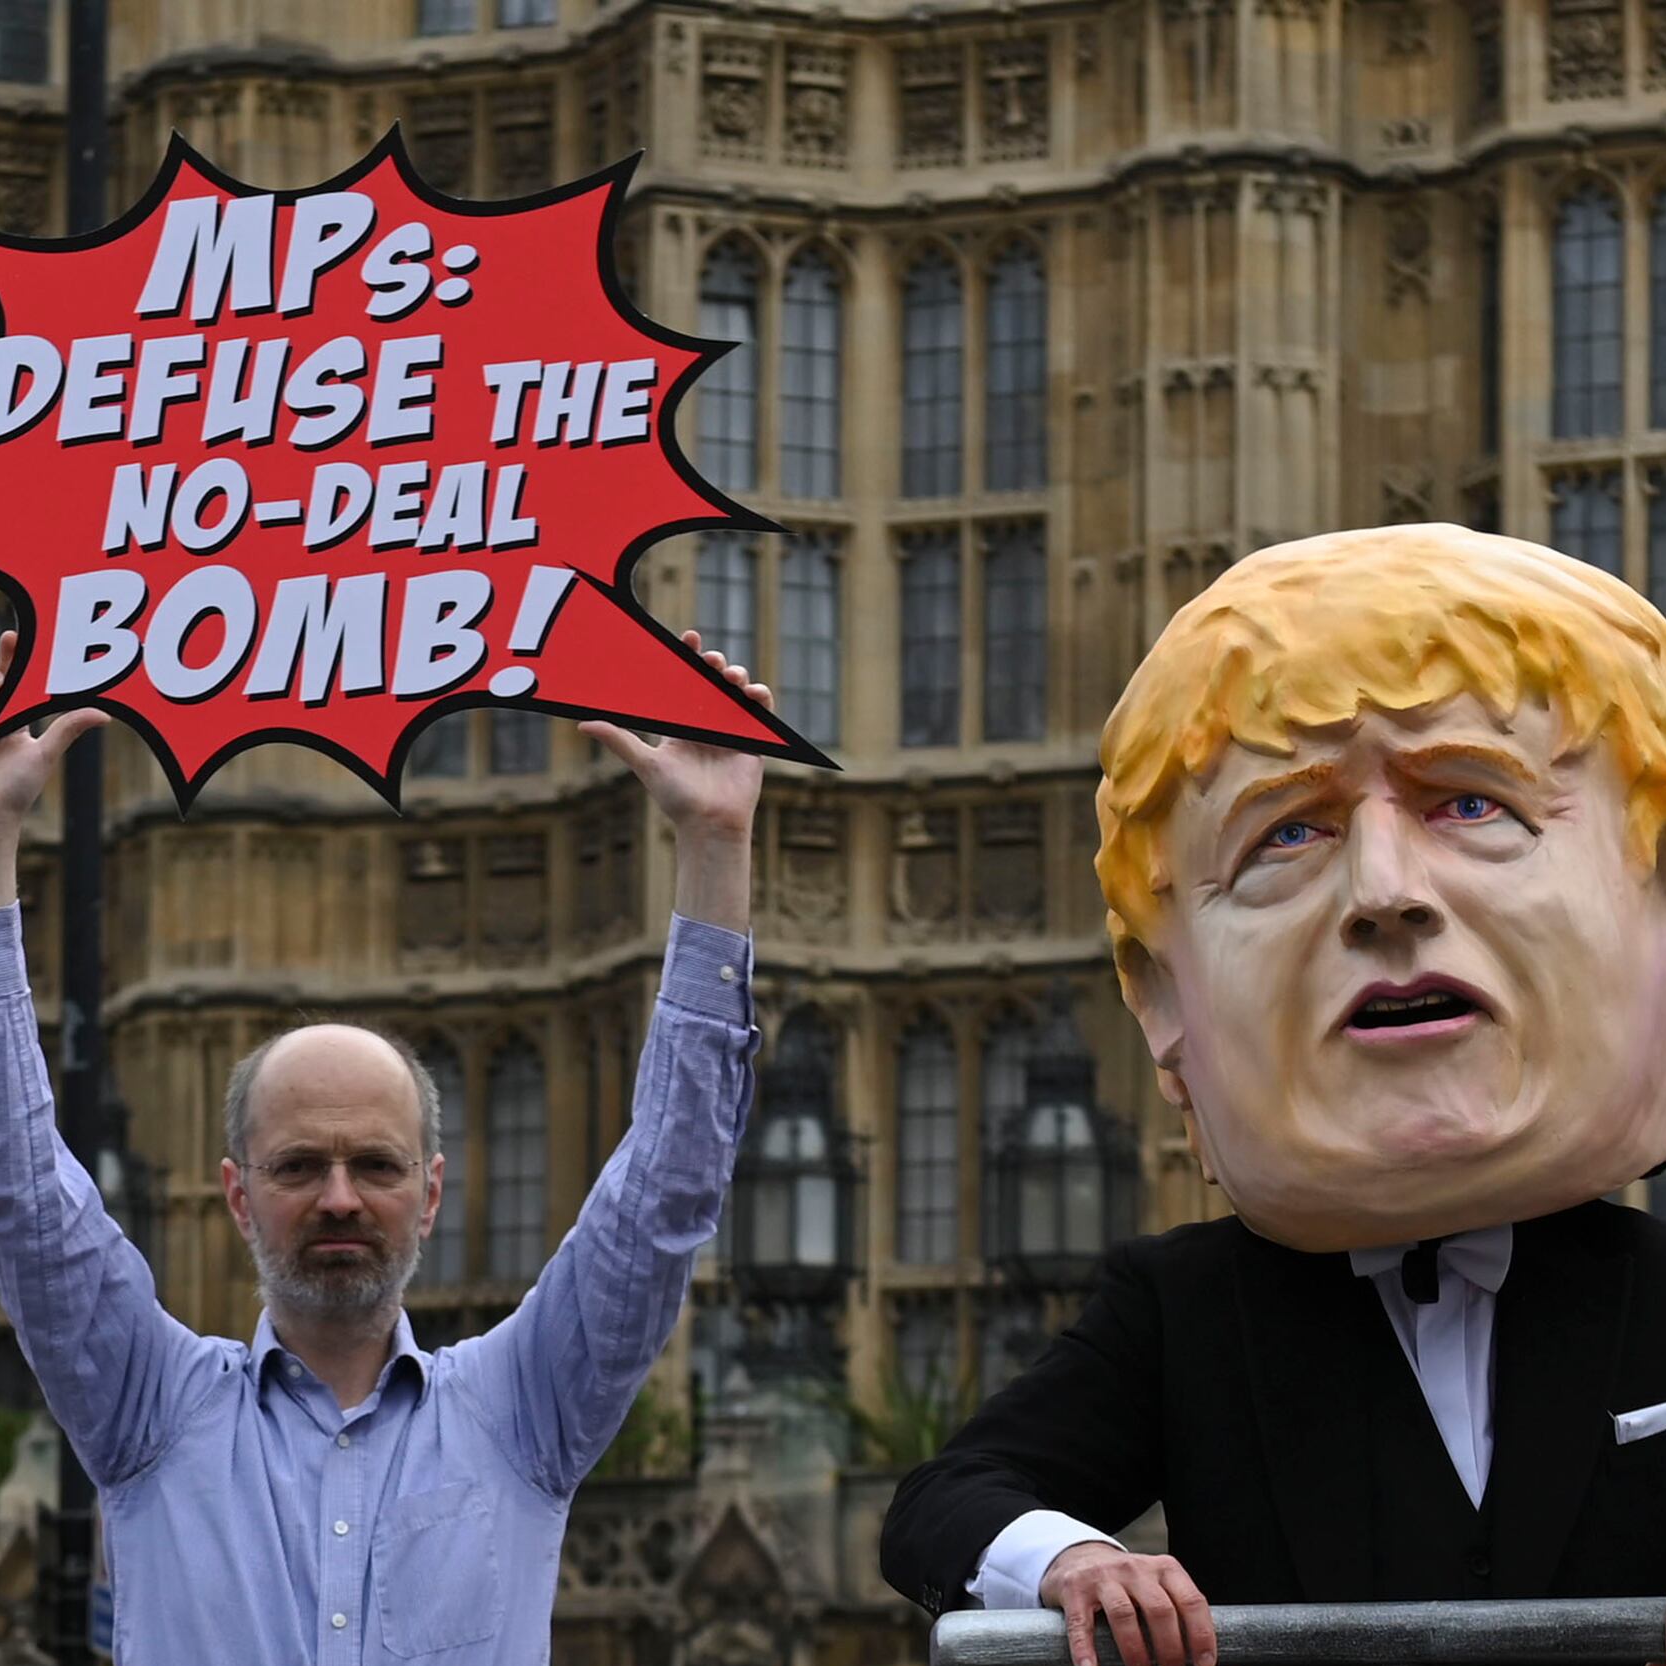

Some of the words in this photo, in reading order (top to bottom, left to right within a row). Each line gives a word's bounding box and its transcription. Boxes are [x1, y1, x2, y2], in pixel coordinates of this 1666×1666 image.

[483, 358, 656, 444] THE
[102, 457, 537, 552] NO-DEAL
[44, 564, 576, 703] BOMB!
